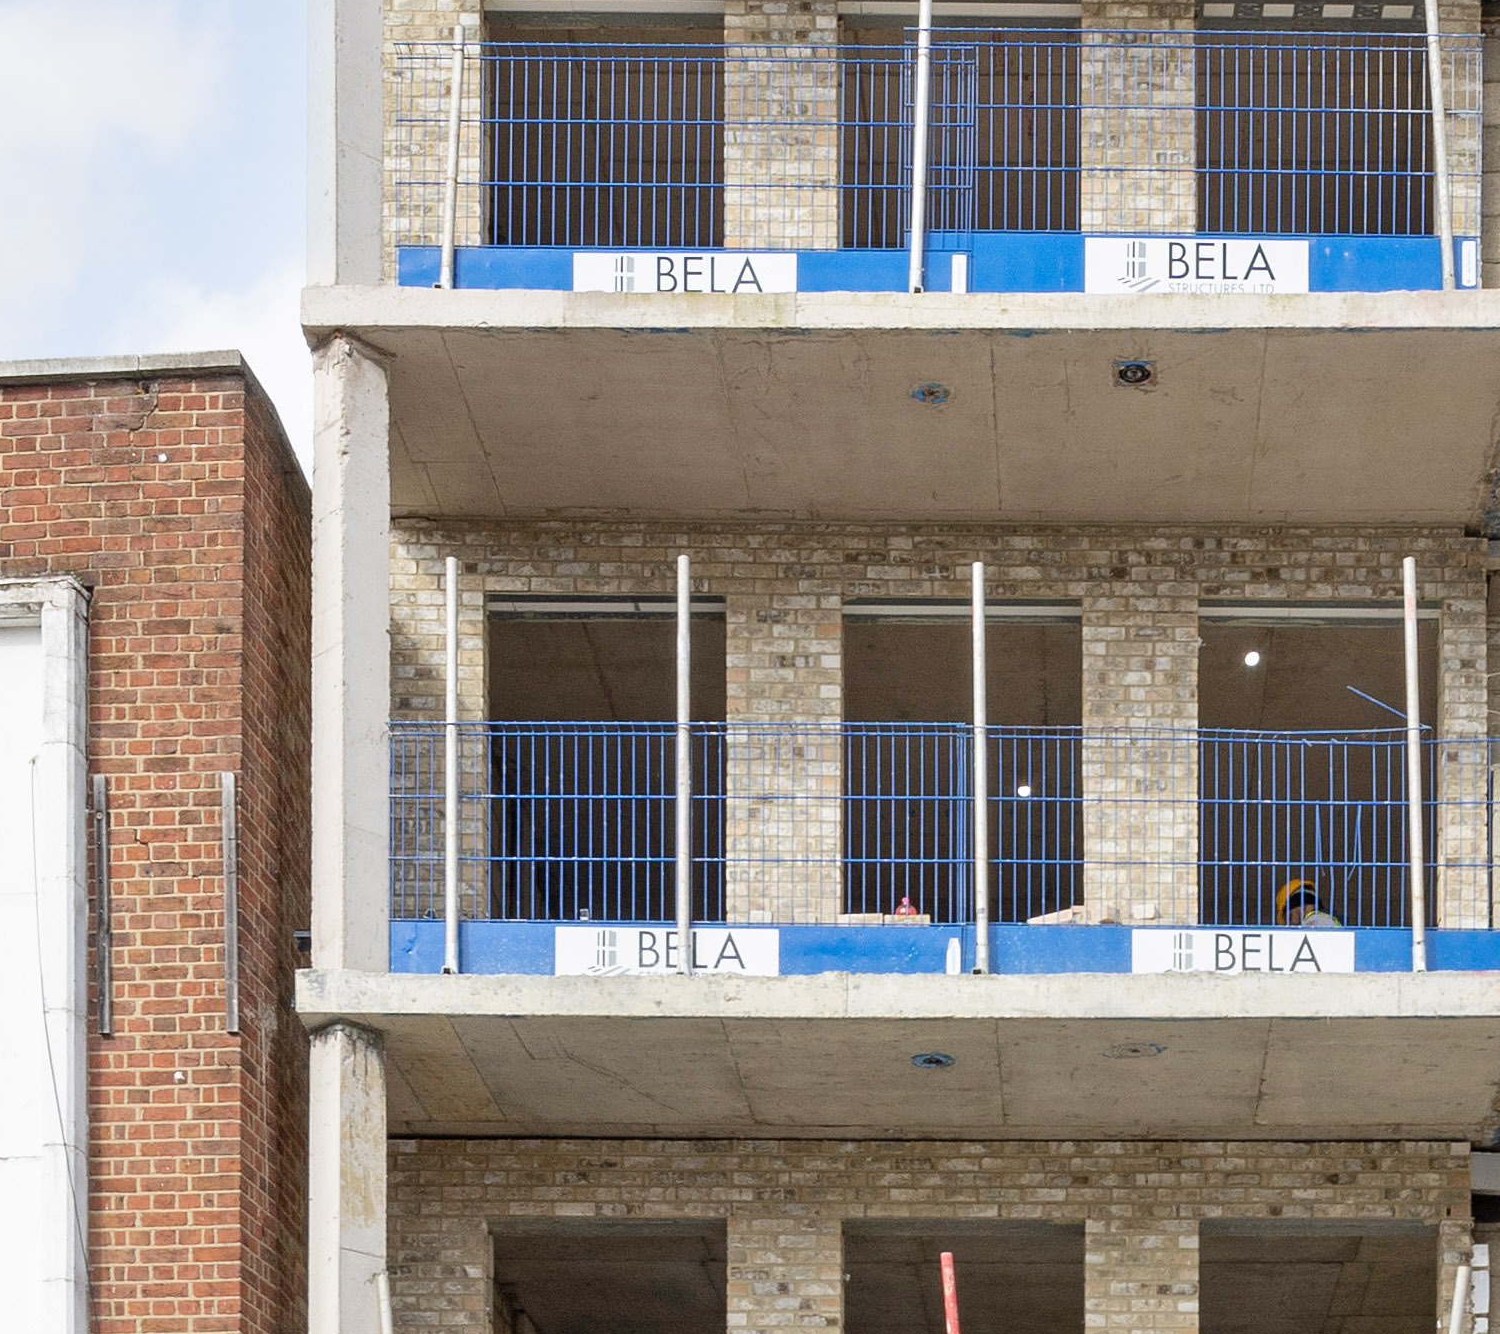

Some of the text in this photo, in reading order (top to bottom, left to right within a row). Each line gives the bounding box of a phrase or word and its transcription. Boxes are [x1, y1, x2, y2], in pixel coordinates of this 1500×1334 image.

[657, 257, 762, 292] BELA
[1169, 242, 1275, 280] BELA
[639, 931, 745, 968] BELA
[1216, 934, 1320, 971] BELA
